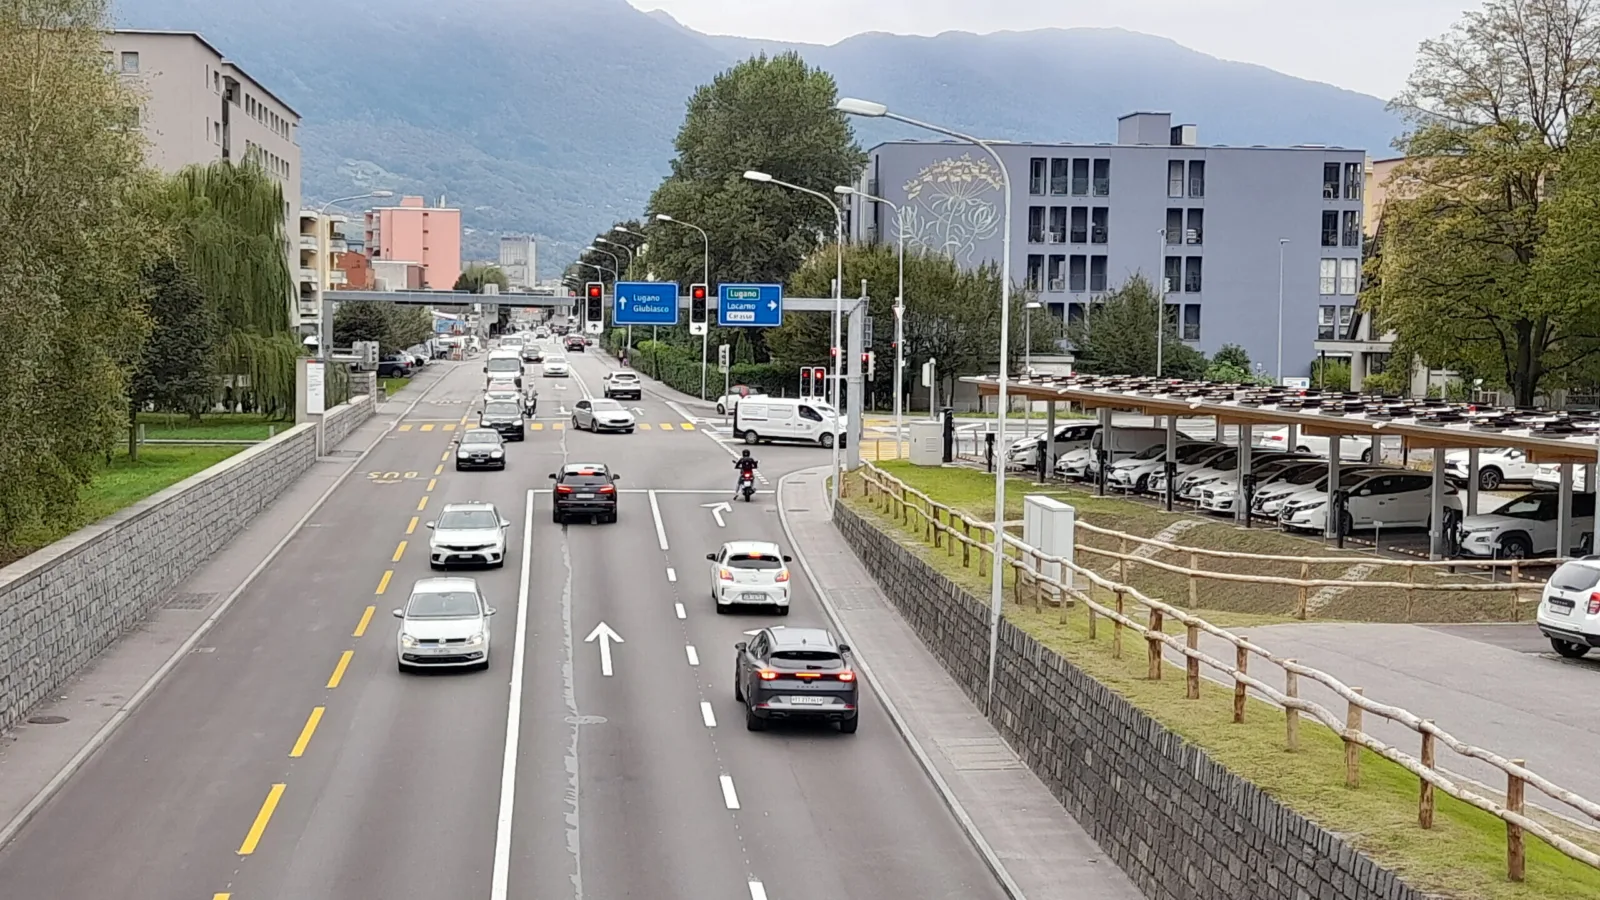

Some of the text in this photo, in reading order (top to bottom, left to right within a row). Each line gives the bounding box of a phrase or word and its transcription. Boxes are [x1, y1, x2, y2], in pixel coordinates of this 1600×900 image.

[633, 294, 660, 303] Lugano
[730, 290, 757, 299] Lugano
[633, 304, 670, 313] Giubiasco
[727, 302, 756, 310] Locarno
[728, 312, 753, 320] Carasso
